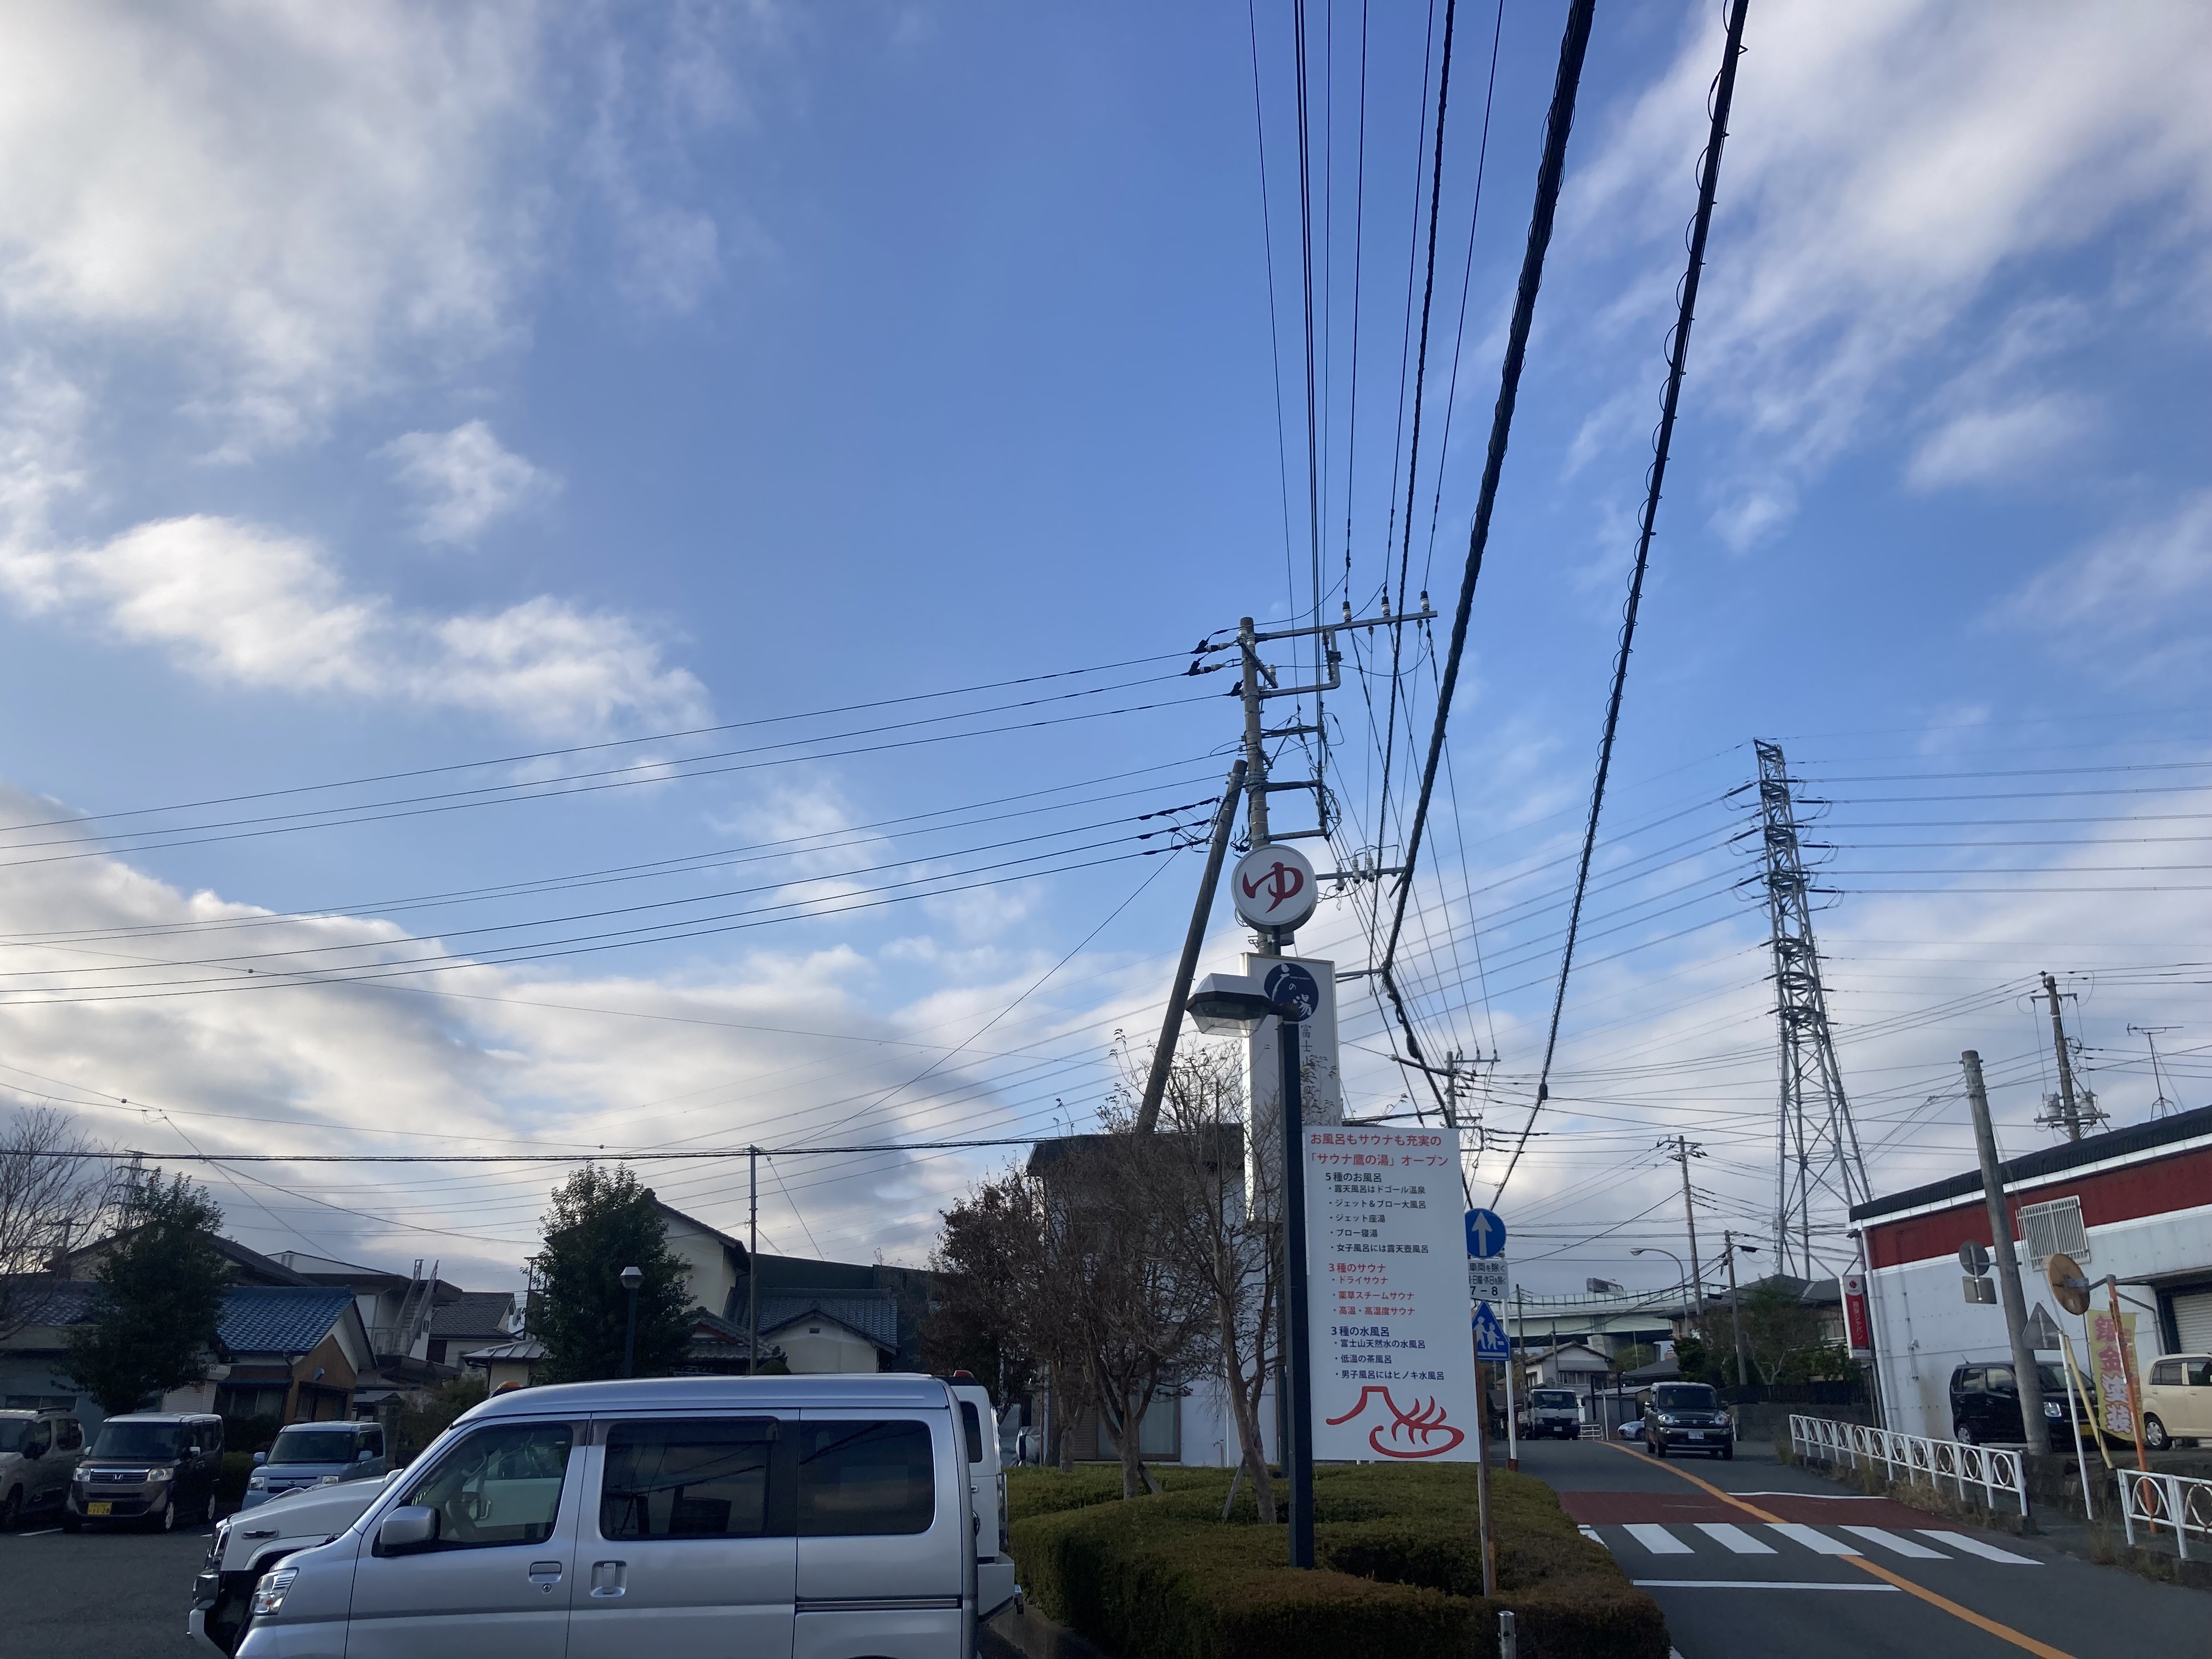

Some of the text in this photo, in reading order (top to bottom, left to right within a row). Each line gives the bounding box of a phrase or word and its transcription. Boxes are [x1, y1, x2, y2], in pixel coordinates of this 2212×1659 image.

[1243, 862, 1304, 913] ゆ
[1311, 1133, 1442, 1147] お風呂もサウナも充実の
[1325, 1172, 1382, 1183] 5種のお風呂
[1329, 1262, 1387, 1273] 3種のサウナ
[1330, 1325, 1390, 1337] 3種の水風呂
